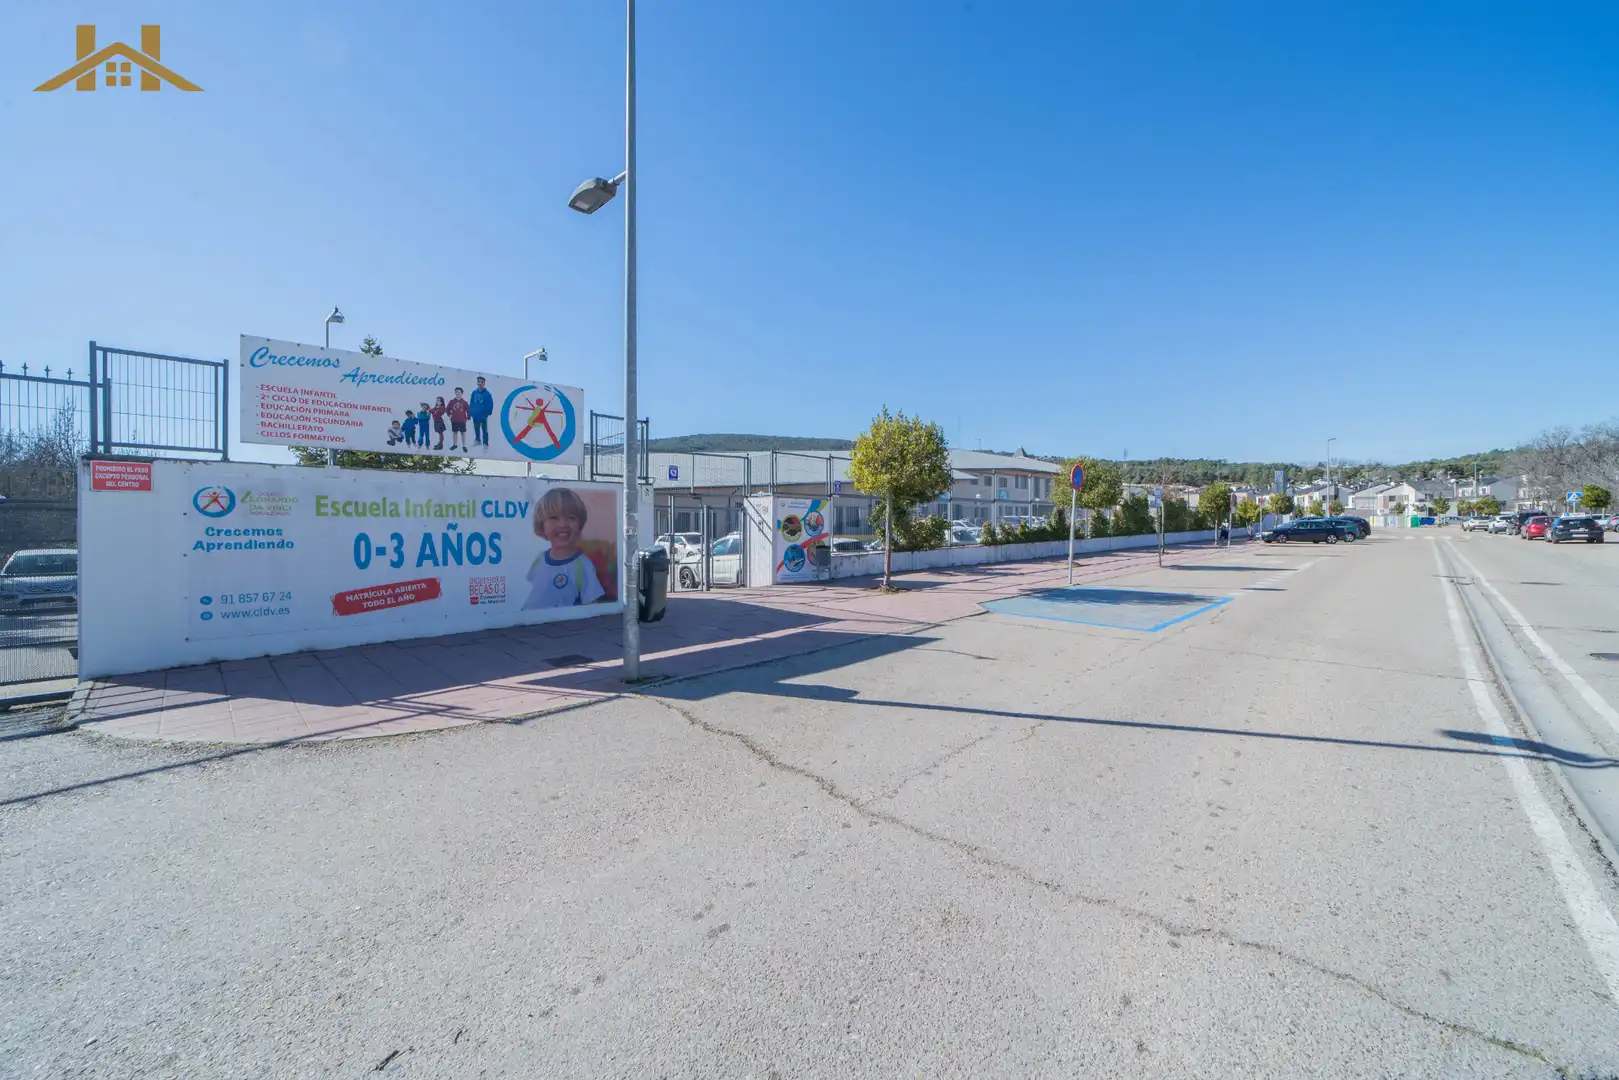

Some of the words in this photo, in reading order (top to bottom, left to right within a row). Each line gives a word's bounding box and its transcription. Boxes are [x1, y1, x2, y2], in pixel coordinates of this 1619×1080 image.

[249, 346, 340, 368] Crecemos
[340, 366, 445, 388] Aprendiendo
[260, 384, 299, 395] ESCUELA
[300, 388, 337, 399] INFANTIL
[271, 394, 297, 403] CICLO
[360, 404, 393, 413] INFANTIL
[260, 421, 324, 432] BACHILLERATO
[312, 416, 364, 427] SECUNDARIA
[260, 430, 292, 439] CICLOS
[292, 432, 346, 443] FORMATIVOS
[315, 495, 400, 517] Escuela
[405, 498, 477, 519] Infantil
[480, 500, 529, 519] CLDV
[205, 526, 283, 537] Crecemos
[192, 539, 295, 552] Aprendiendo
[353, 532, 405, 570] 0-3
[415, 522, 503, 568] AÑOS
[394, 582, 427, 595] ABIERTA
[469, 584, 493, 596] BECAS
[220, 594, 235, 605] 91
[238, 593, 259, 604] 857
[262, 591, 276, 602] 67
[279, 591, 292, 601] 24
[361, 598, 385, 609] TODO
[386, 596, 397, 605] EL
[397, 593, 415, 603] AÑO
[220, 606, 291, 619] www.cldv.es
